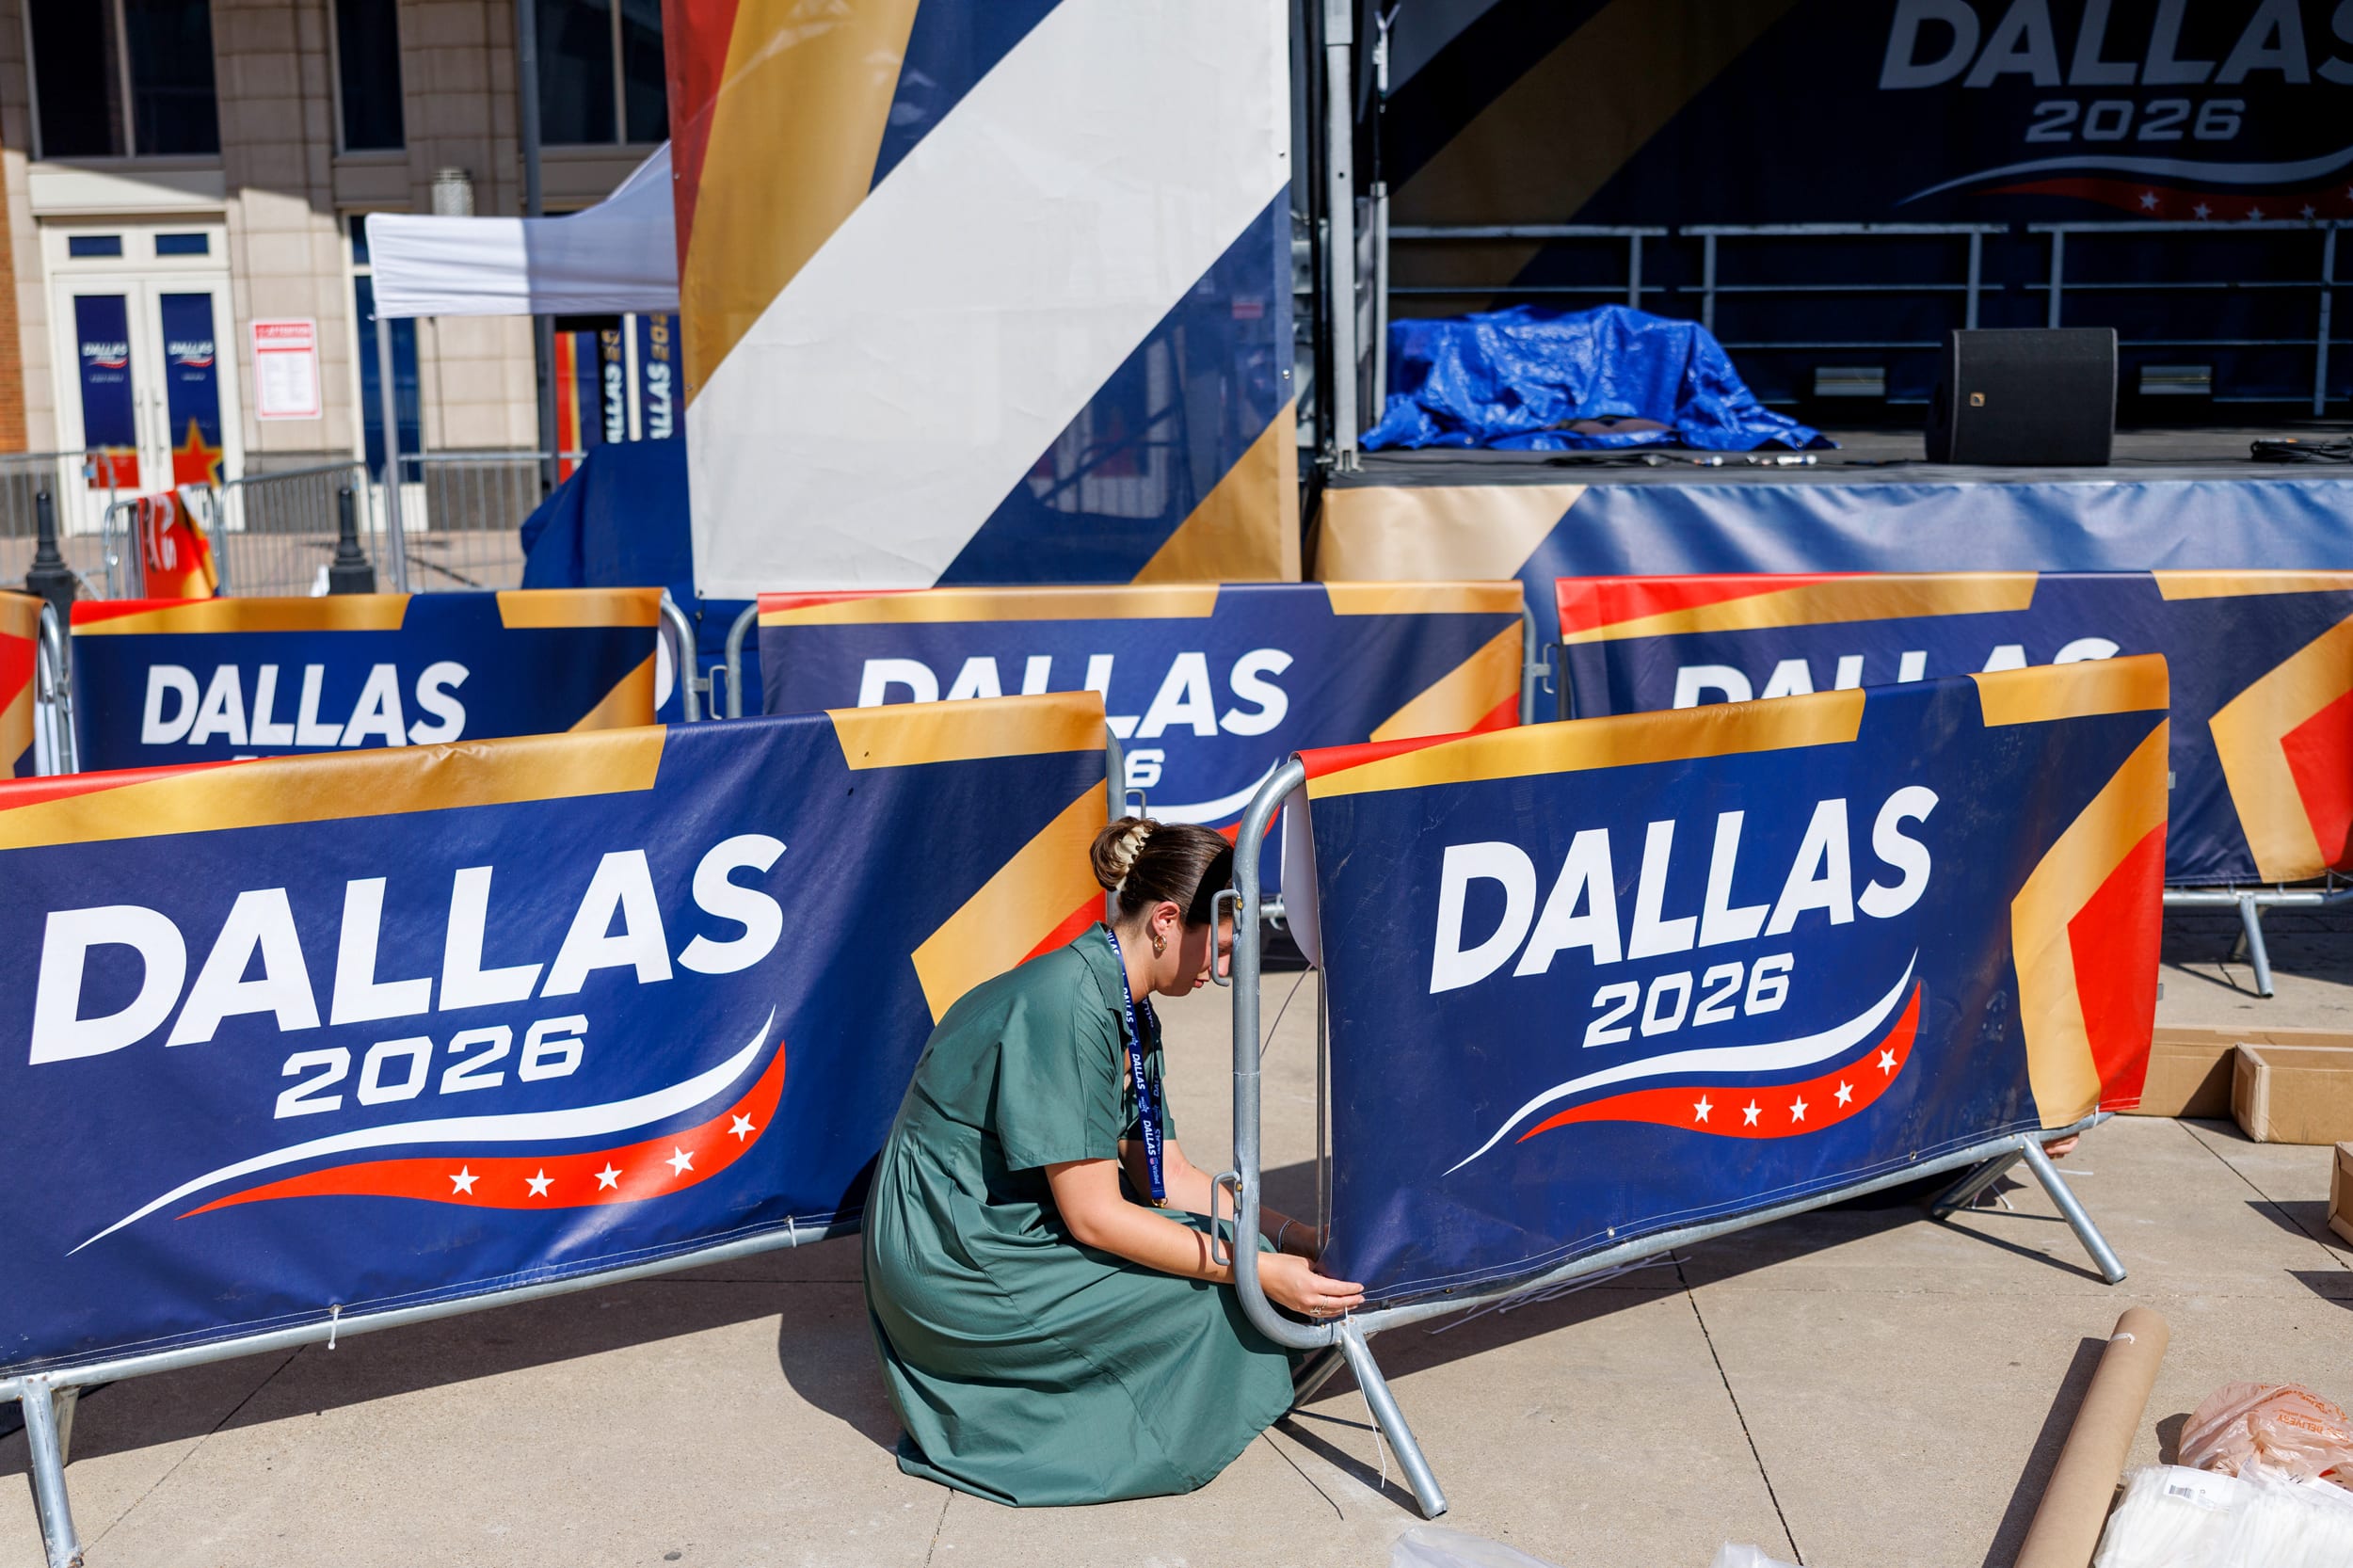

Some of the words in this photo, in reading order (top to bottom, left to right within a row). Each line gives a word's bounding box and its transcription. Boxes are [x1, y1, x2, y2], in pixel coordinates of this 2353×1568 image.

[2025, 99, 2247, 143] 2026
[605, 362, 623, 442] LLAS
[647, 361, 672, 439] LLAS
[141, 661, 471, 747] DALLAS
[1429, 785, 1940, 995] DALLAS
[29, 834, 788, 1065] DALLAS
[1582, 952, 1795, 1048] 2026
[274, 1014, 589, 1119] 2026
[1132, 1053, 1145, 1090] DALLAS
[1144, 1120, 1157, 1156] DALLAS
